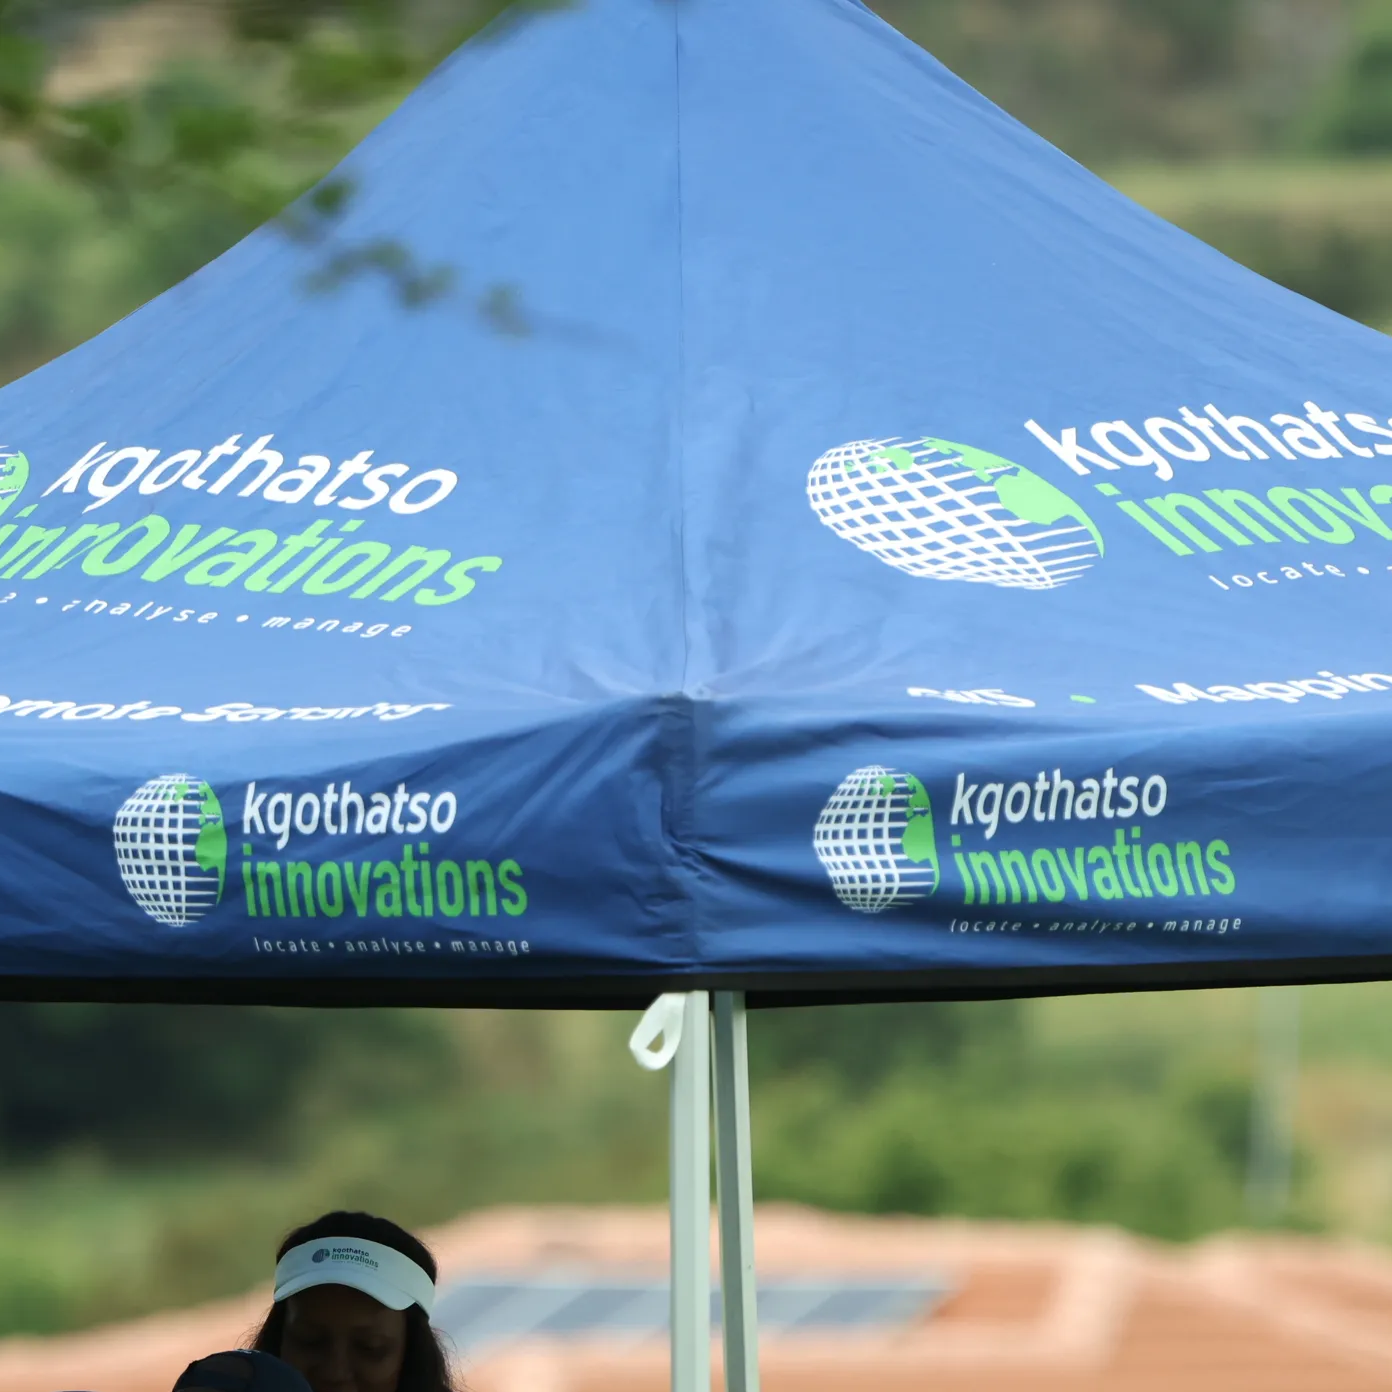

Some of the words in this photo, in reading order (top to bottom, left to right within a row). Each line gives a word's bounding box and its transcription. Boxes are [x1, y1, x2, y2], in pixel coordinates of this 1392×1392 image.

[41, 433, 458, 514] kgothatso
[1208, 562, 1345, 590] locate
[262, 616, 412, 638] manage
[242, 781, 457, 850] kgothatso
[950, 768, 1167, 840] kgothatso
[242, 842, 528, 918] innovations
[951, 826, 1235, 905] innovations
[254, 937, 321, 952] locate
[346, 937, 426, 954] analyse
[451, 938, 530, 955] manage
[950, 919, 1022, 933] locate
[1049, 919, 1136, 933] analyse
[1163, 916, 1241, 934] manage
[331, 1252, 378, 1268] innovations
